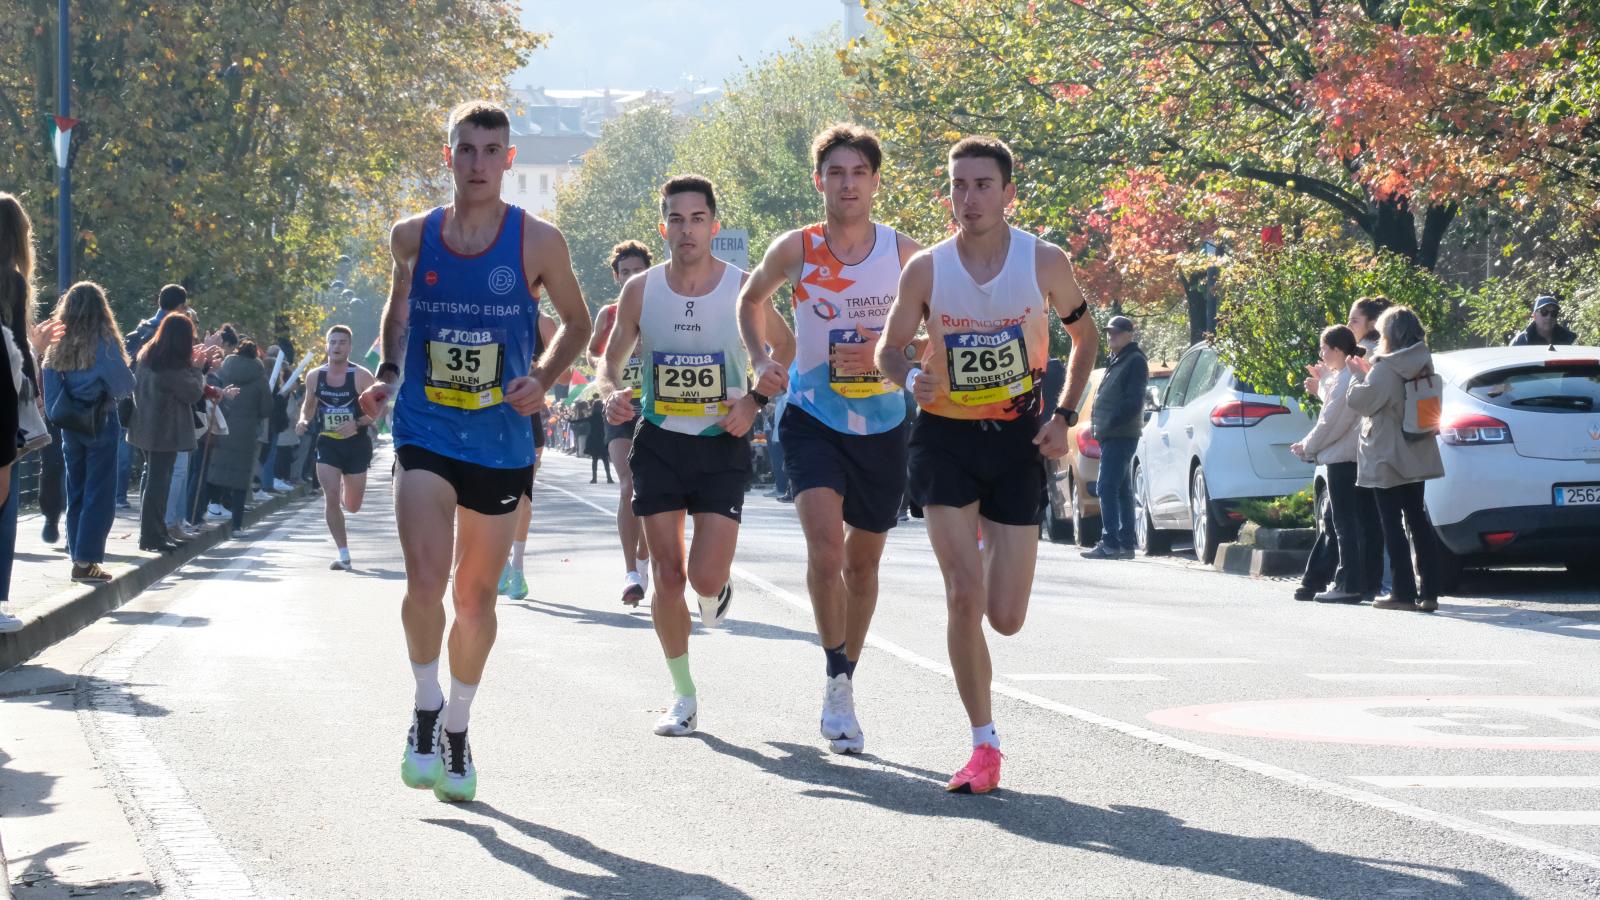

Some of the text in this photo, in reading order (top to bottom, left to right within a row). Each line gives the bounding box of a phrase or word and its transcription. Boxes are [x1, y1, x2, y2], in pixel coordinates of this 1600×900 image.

[711, 237, 744, 250] TERIA
[415, 300, 521, 317] ATLETISMO EIBAR
[848, 310, 866, 319] LAS
[446, 347, 481, 373] 35
[960, 345, 1015, 373] 265
[450, 374, 480, 385] JULEN
[622, 366, 643, 380] 27
[664, 368, 714, 388] 296
[966, 369, 1014, 384] ROBERTO
